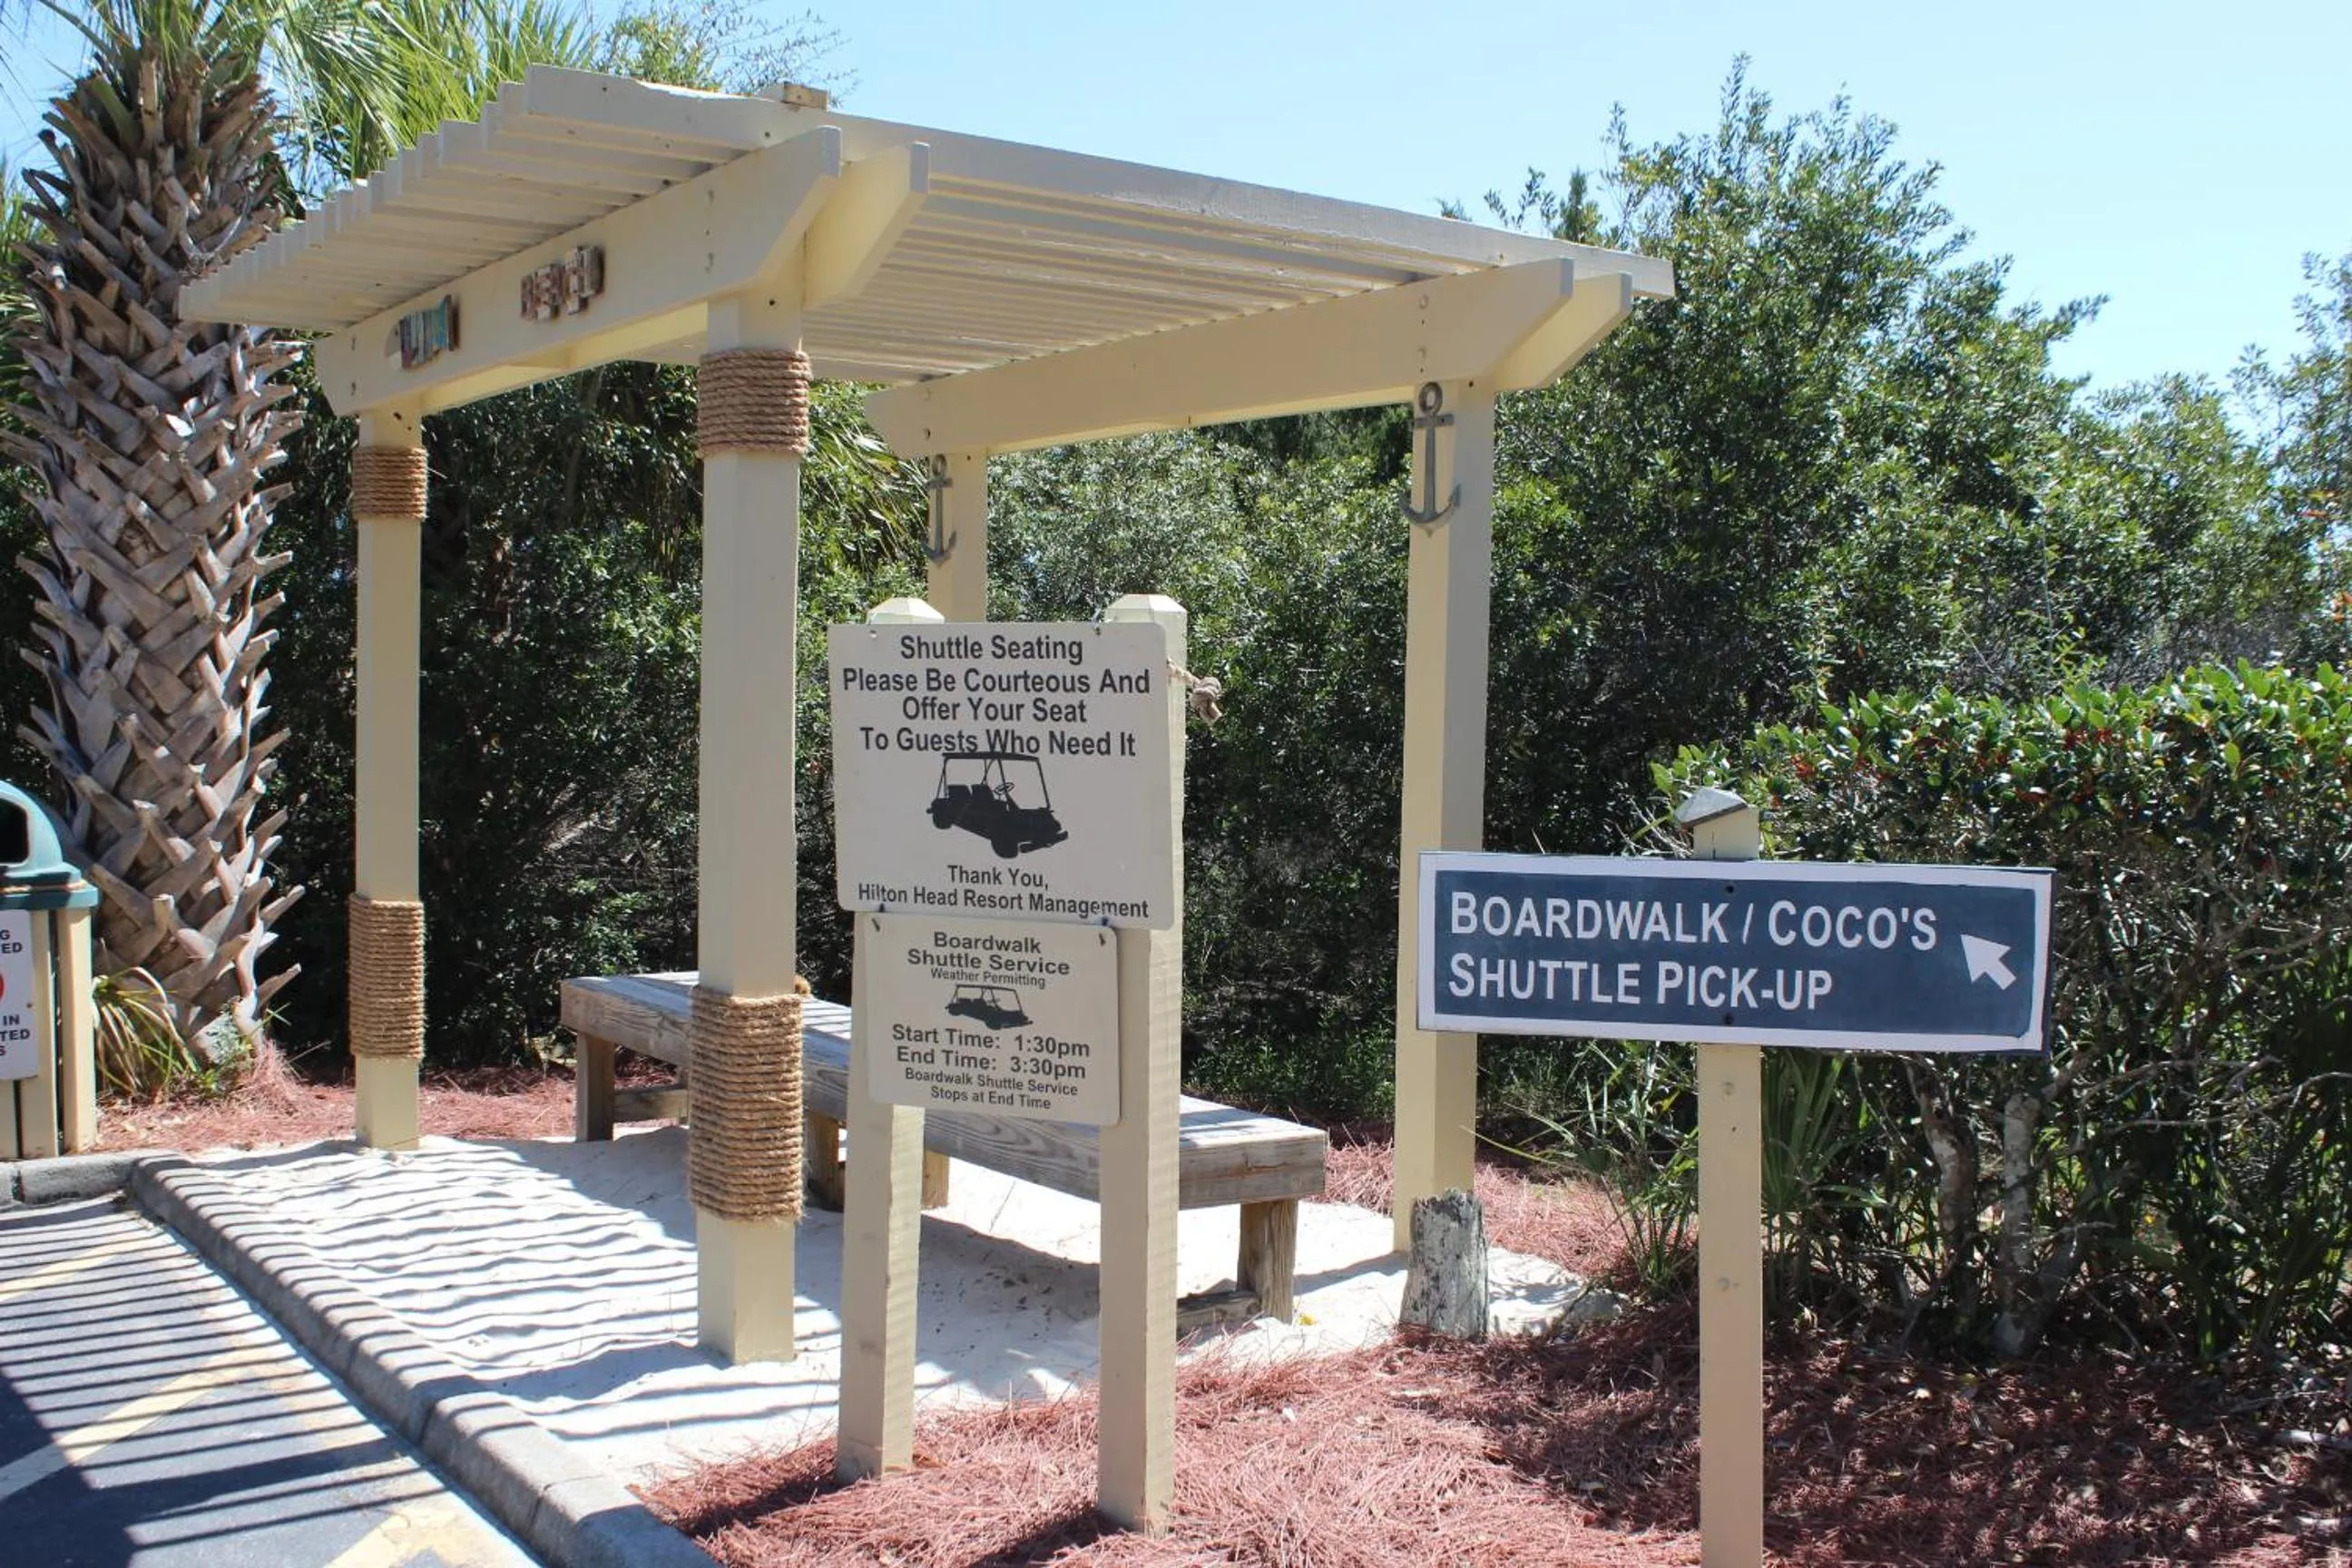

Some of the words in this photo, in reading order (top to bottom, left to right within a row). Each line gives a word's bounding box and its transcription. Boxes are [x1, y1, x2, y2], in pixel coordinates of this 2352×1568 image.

[901, 636, 983, 660] Shuttle
[992, 638, 1083, 665] Seating
[844, 668, 917, 691] Please
[926, 669, 956, 691] Be
[964, 668, 1089, 693] Courteous
[1099, 669, 1150, 693] And
[902, 698, 960, 720] Offer
[968, 698, 1024, 721] Your
[1033, 699, 1087, 722] Seat
[860, 728, 888, 750] To
[897, 729, 978, 753] Guests
[985, 730, 1040, 754] Who
[1049, 731, 1111, 756] Need
[1121, 732, 1135, 756] It
[947, 866, 1002, 886] Thank
[1008, 867, 1048, 889] You,
[858, 884, 906, 903] Hilton
[914, 886, 957, 906] Head
[965, 888, 1021, 909] Resort
[1029, 891, 1148, 918] Management
[1451, 892, 1729, 944] BOARDWALK
[1742, 904, 1753, 944] /
[1768, 901, 1937, 951] COCO'S
[934, 931, 1042, 954] Boardwalk
[908, 949, 982, 969] Shuttle
[989, 955, 1070, 975] Service
[931, 967, 978, 982] Weather
[984, 972, 1045, 989] Permitting
[1449, 953, 1641, 1004] SHUTTLE
[1657, 961, 1832, 1010] PICK-UP
[3, 1014, 20, 1025] IN
[893, 1024, 938, 1044] Start
[946, 1029, 1000, 1048] Time:
[1014, 1035, 1089, 1058] 1:30pm
[897, 1046, 935, 1063] End
[942, 1050, 997, 1071] Time:
[1011, 1056, 1086, 1080] 3:30pm
[906, 1067, 973, 1085] Boardwalk
[977, 1074, 1024, 1090] Shuttle
[1028, 1080, 1078, 1096] Service
[931, 1086, 968, 1102] Stops
[972, 1092, 984, 1102] at
[989, 1091, 1014, 1105] End
[1020, 1095, 1051, 1109] Time
